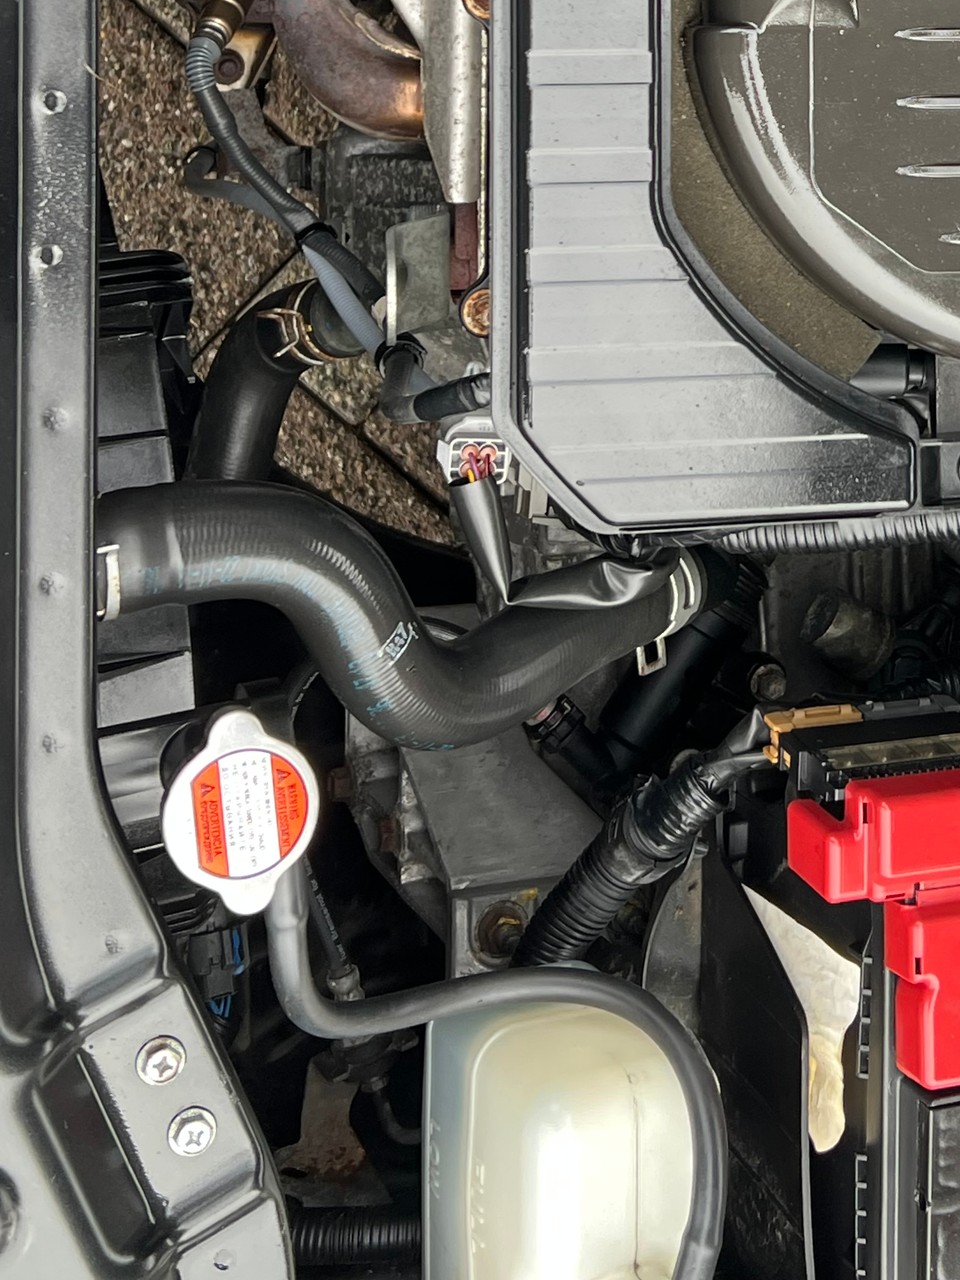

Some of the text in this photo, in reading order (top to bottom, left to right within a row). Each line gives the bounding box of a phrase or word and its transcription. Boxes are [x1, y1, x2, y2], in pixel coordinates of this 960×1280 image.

[208, 800, 222, 858] ADVERTENCIA
[276, 786, 291, 848] AVERTISSEMENT
[287, 783, 300, 821] WARNING
[429, 1118, 441, 1199] LOW
